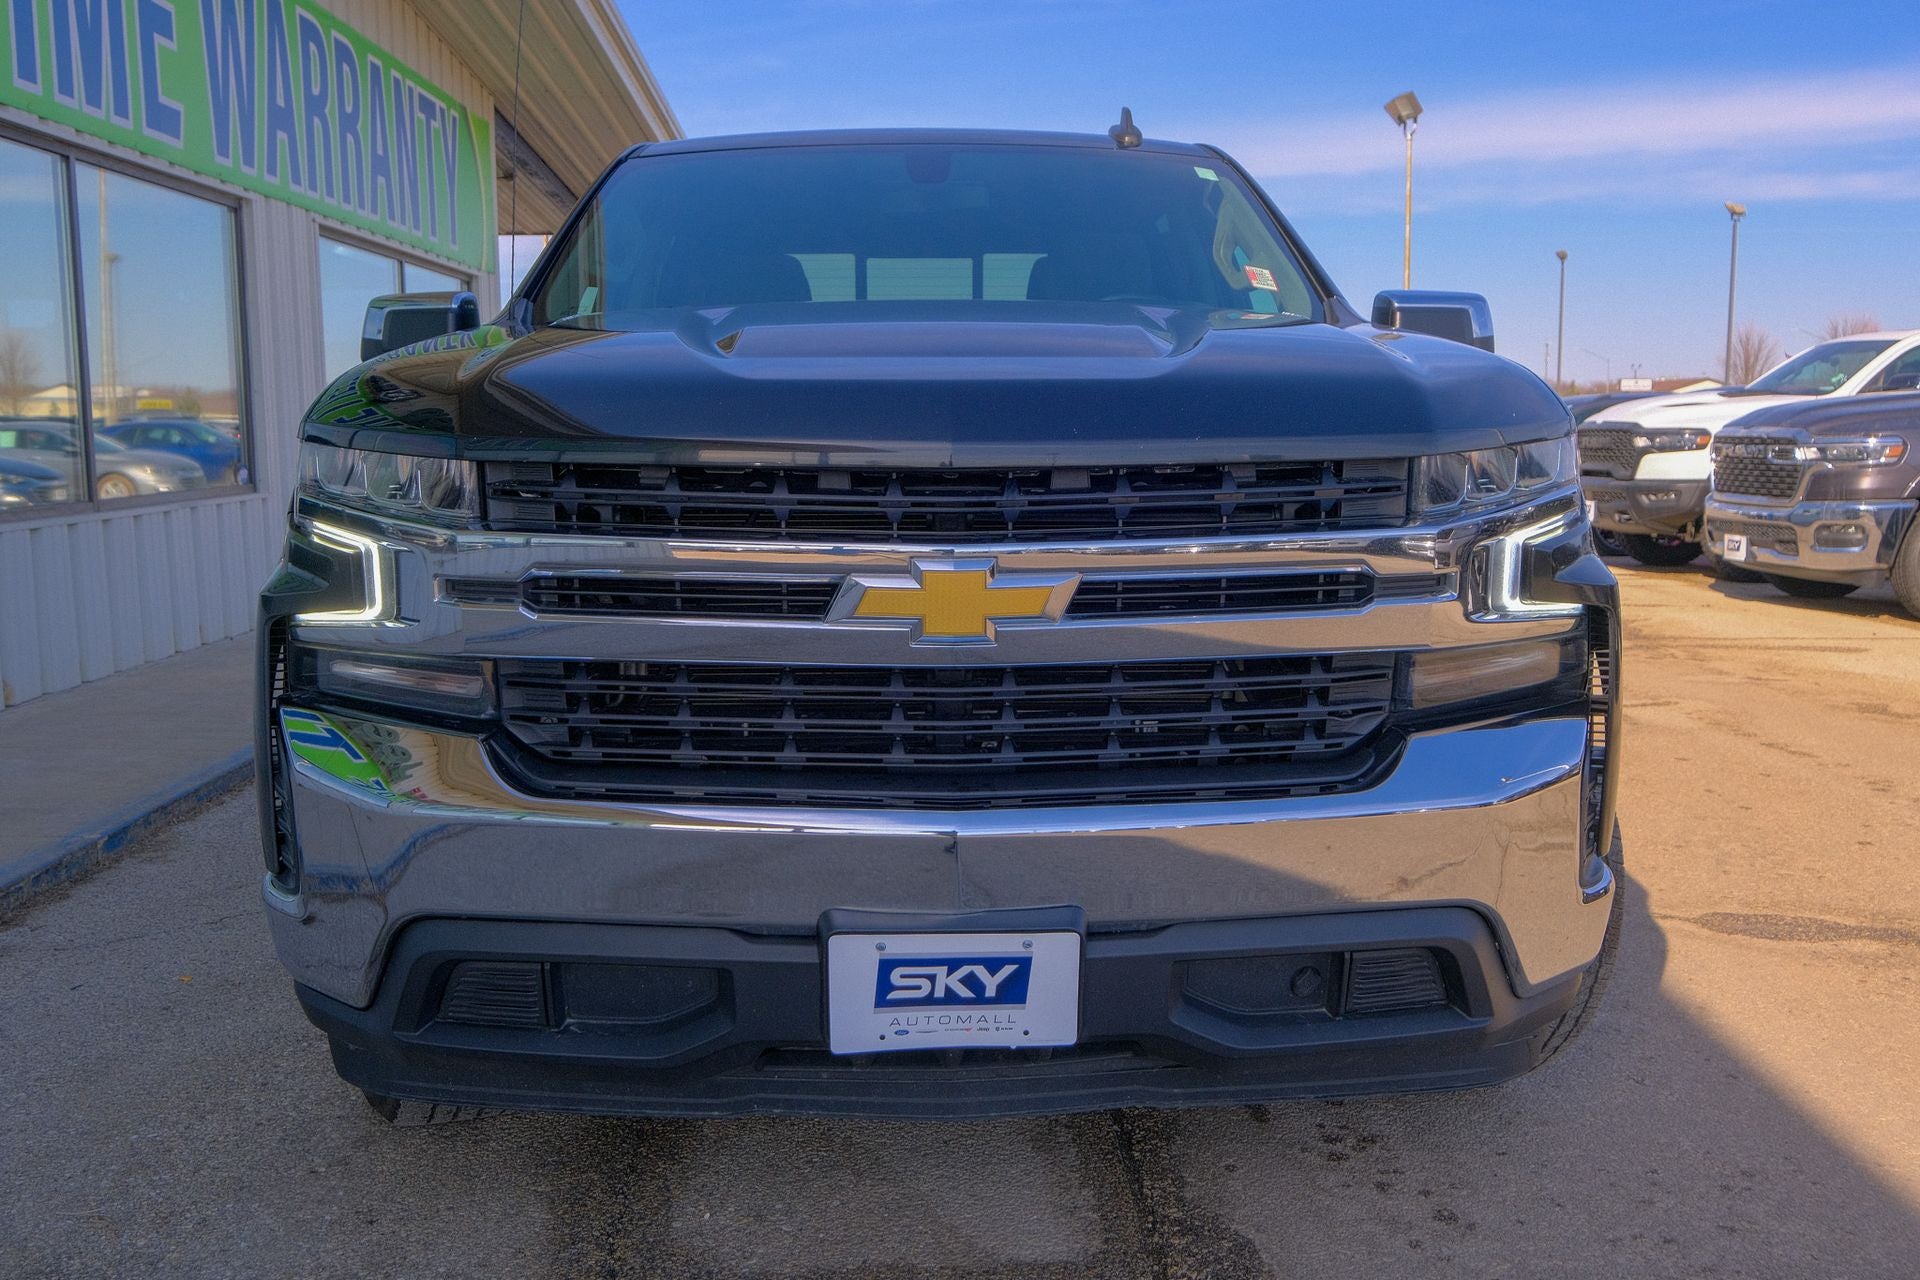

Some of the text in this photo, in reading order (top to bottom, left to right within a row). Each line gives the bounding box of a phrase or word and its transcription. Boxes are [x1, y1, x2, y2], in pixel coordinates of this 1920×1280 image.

[200, 0, 459, 250] WARRANTY
[886, 965, 1020, 999] SKY
[889, 1014, 1016, 1027] AUTOMALL
